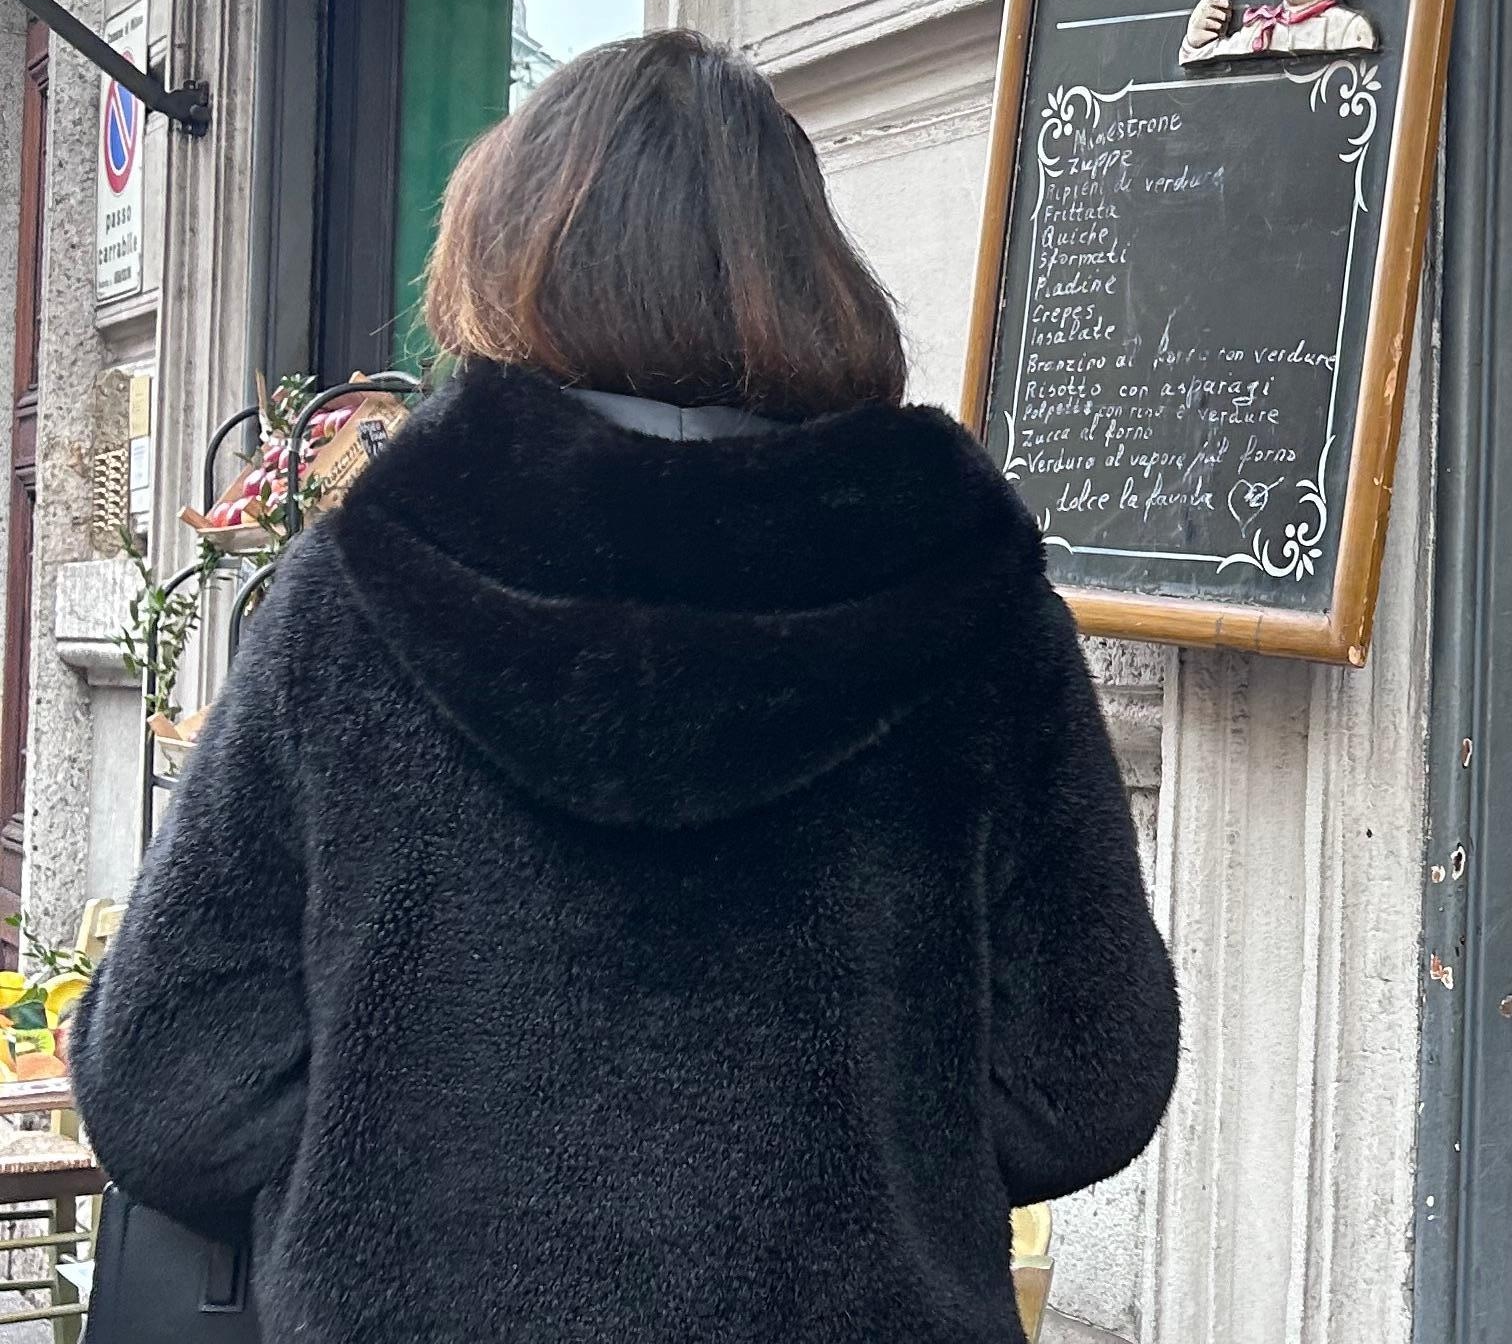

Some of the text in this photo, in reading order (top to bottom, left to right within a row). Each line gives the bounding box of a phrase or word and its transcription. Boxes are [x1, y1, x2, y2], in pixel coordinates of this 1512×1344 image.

[1043, 201, 1120, 223] Frittata
[1041, 222, 1109, 250] Quiche
[1031, 303, 1096, 329] Crepes
[1030, 315, 1116, 347] Insalate
[1024, 375, 1102, 402] Risotto
[1104, 419, 1154, 448] forno
[1104, 442, 1125, 467] al
[1237, 434, 1297, 475] forno
